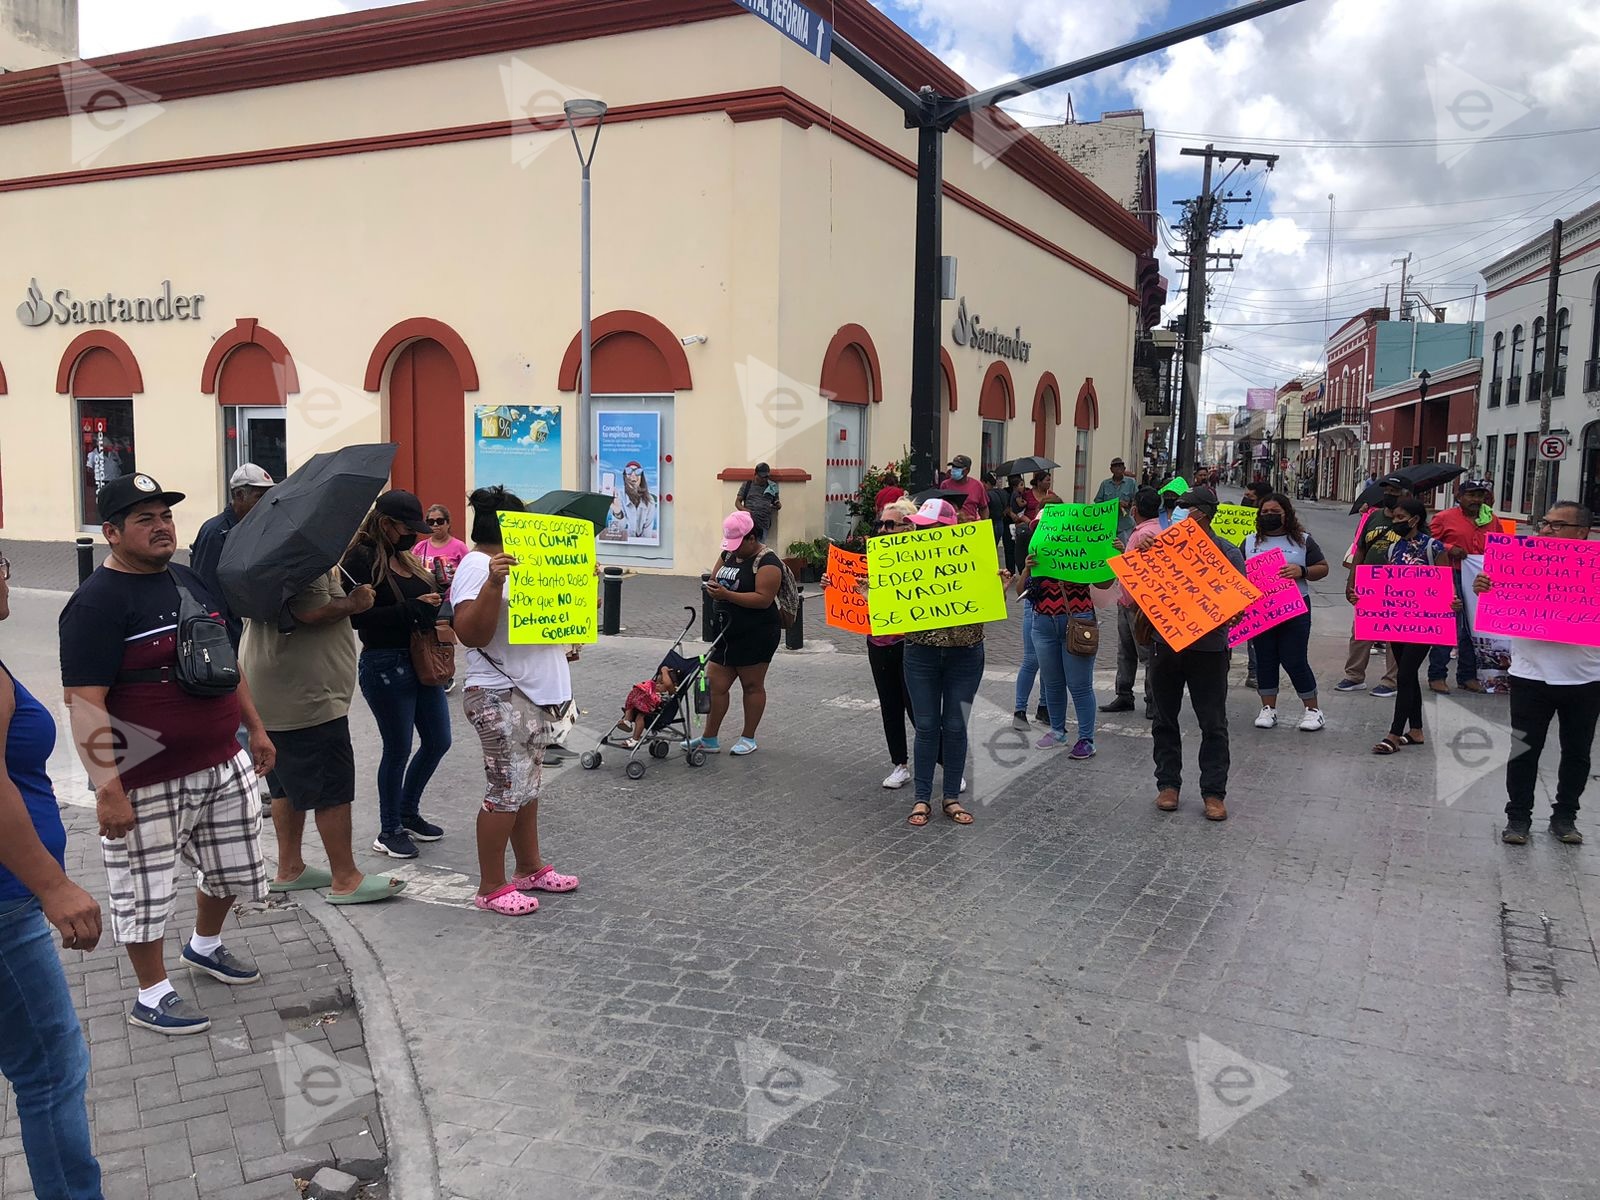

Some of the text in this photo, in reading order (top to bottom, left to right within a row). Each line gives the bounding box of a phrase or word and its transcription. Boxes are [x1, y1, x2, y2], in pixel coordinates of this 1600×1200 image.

[770, 0, 809, 45] REFORMA
[53, 280, 205, 325] Santander
[969, 314, 1031, 364] Santander
[1082, 502, 1117, 518] CUMAT
[1061, 523, 1105, 532] MIGUEL
[504, 532, 521, 546] de
[538, 532, 578, 549] CUMAT
[880, 530, 943, 548] SILENCIO
[951, 525, 976, 538] NO
[1044, 533, 1081, 543] ANGEL
[1487, 534, 1511, 544] NO
[544, 553, 589, 566] VIOLENCIA
[878, 544, 968, 568] SIGNIFICA
[1041, 547, 1087, 558] SUSANA
[1160, 527, 1227, 594] BASTA DE
[1196, 539, 1229, 576] RUBEN
[1049, 558, 1106, 571] JIMENEZ
[1371, 565, 1441, 579] EXIGIMOS
[1521, 566, 1581, 579] CUMAT
[520, 570, 535, 587] de
[868, 561, 976, 589] CEDER AQUI
[557, 592, 572, 606] NO
[896, 580, 963, 601] NADIE
[1122, 573, 1183, 639] LA CUMAT
[1382, 599, 1419, 609] INSUS
[873, 611, 903, 628] SE
[1186, 621, 1204, 637] DE
